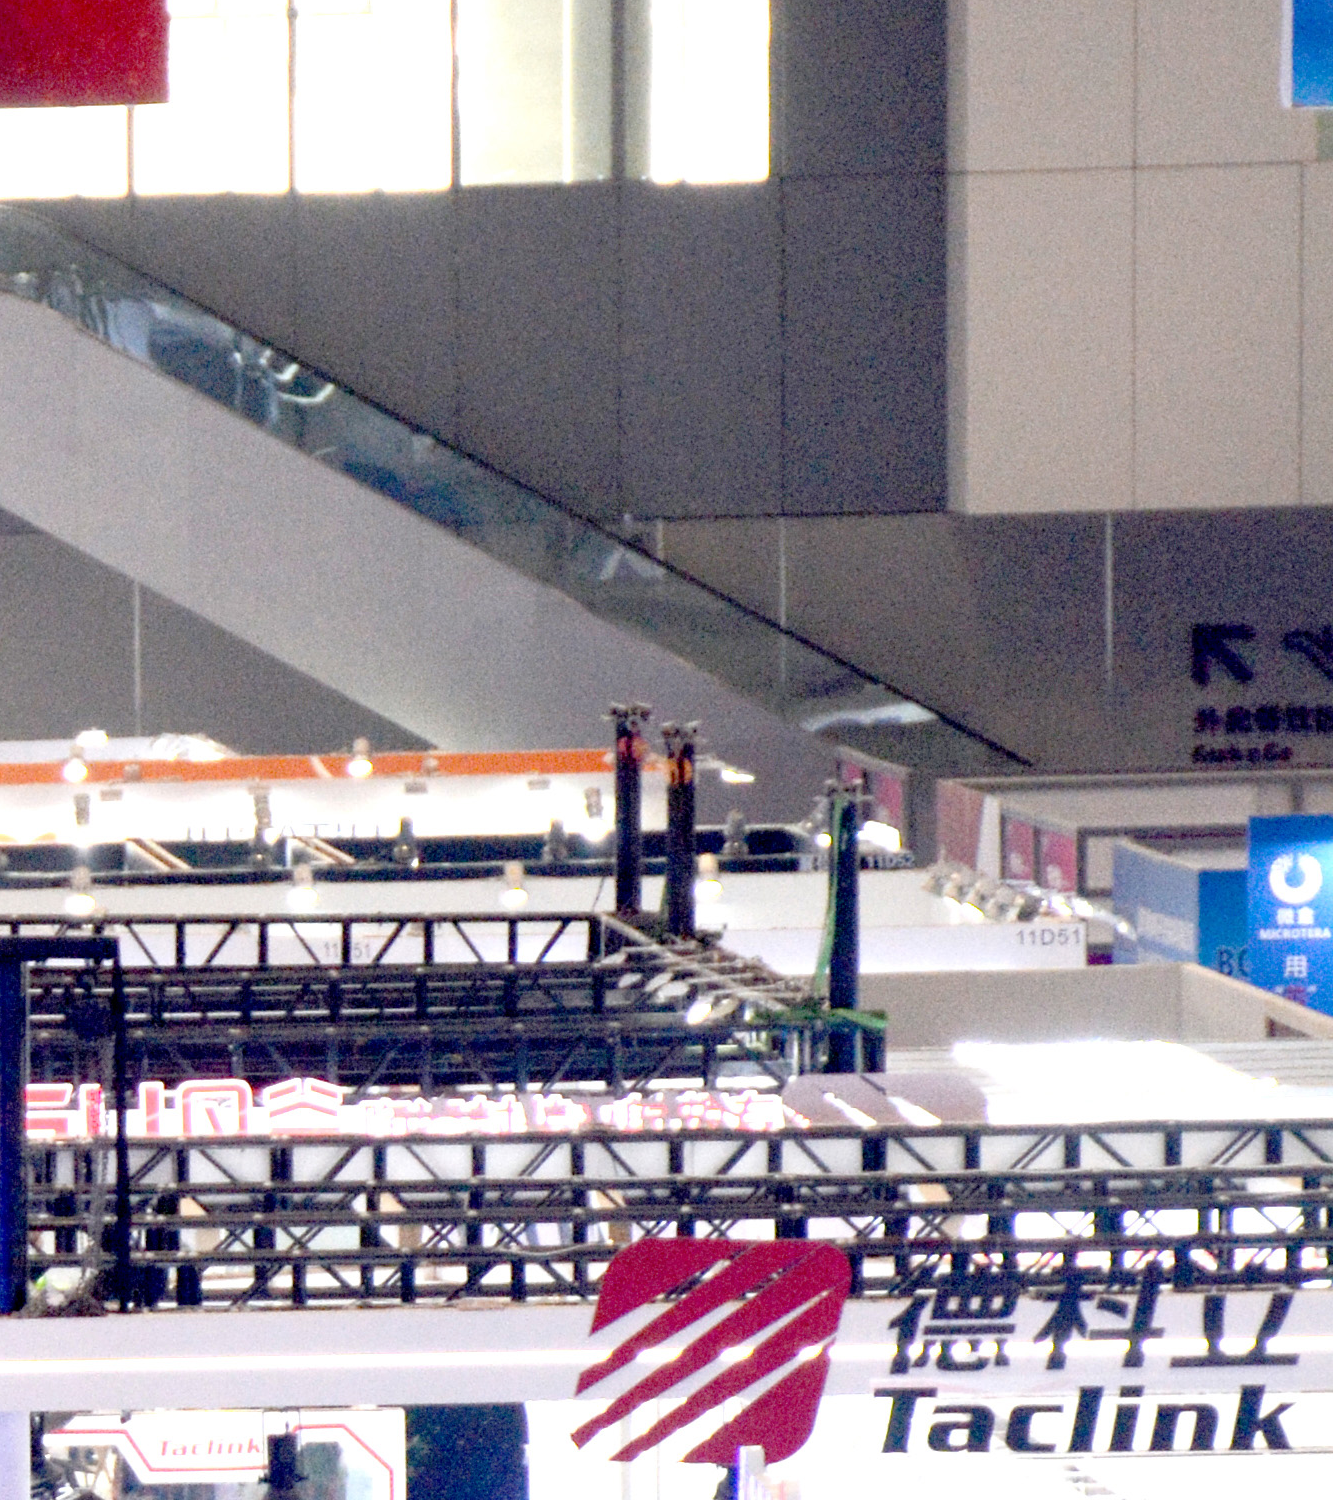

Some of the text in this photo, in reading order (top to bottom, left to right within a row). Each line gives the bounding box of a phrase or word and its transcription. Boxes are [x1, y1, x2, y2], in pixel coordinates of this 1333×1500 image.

[1016, 928, 1082, 947] 11D51
[322, 939, 371, 961] 1151
[889, 1262, 1300, 1374] 德科立
[874, 1384, 1296, 1454] Taclink
[161, 1438, 261, 1456] Taclink
